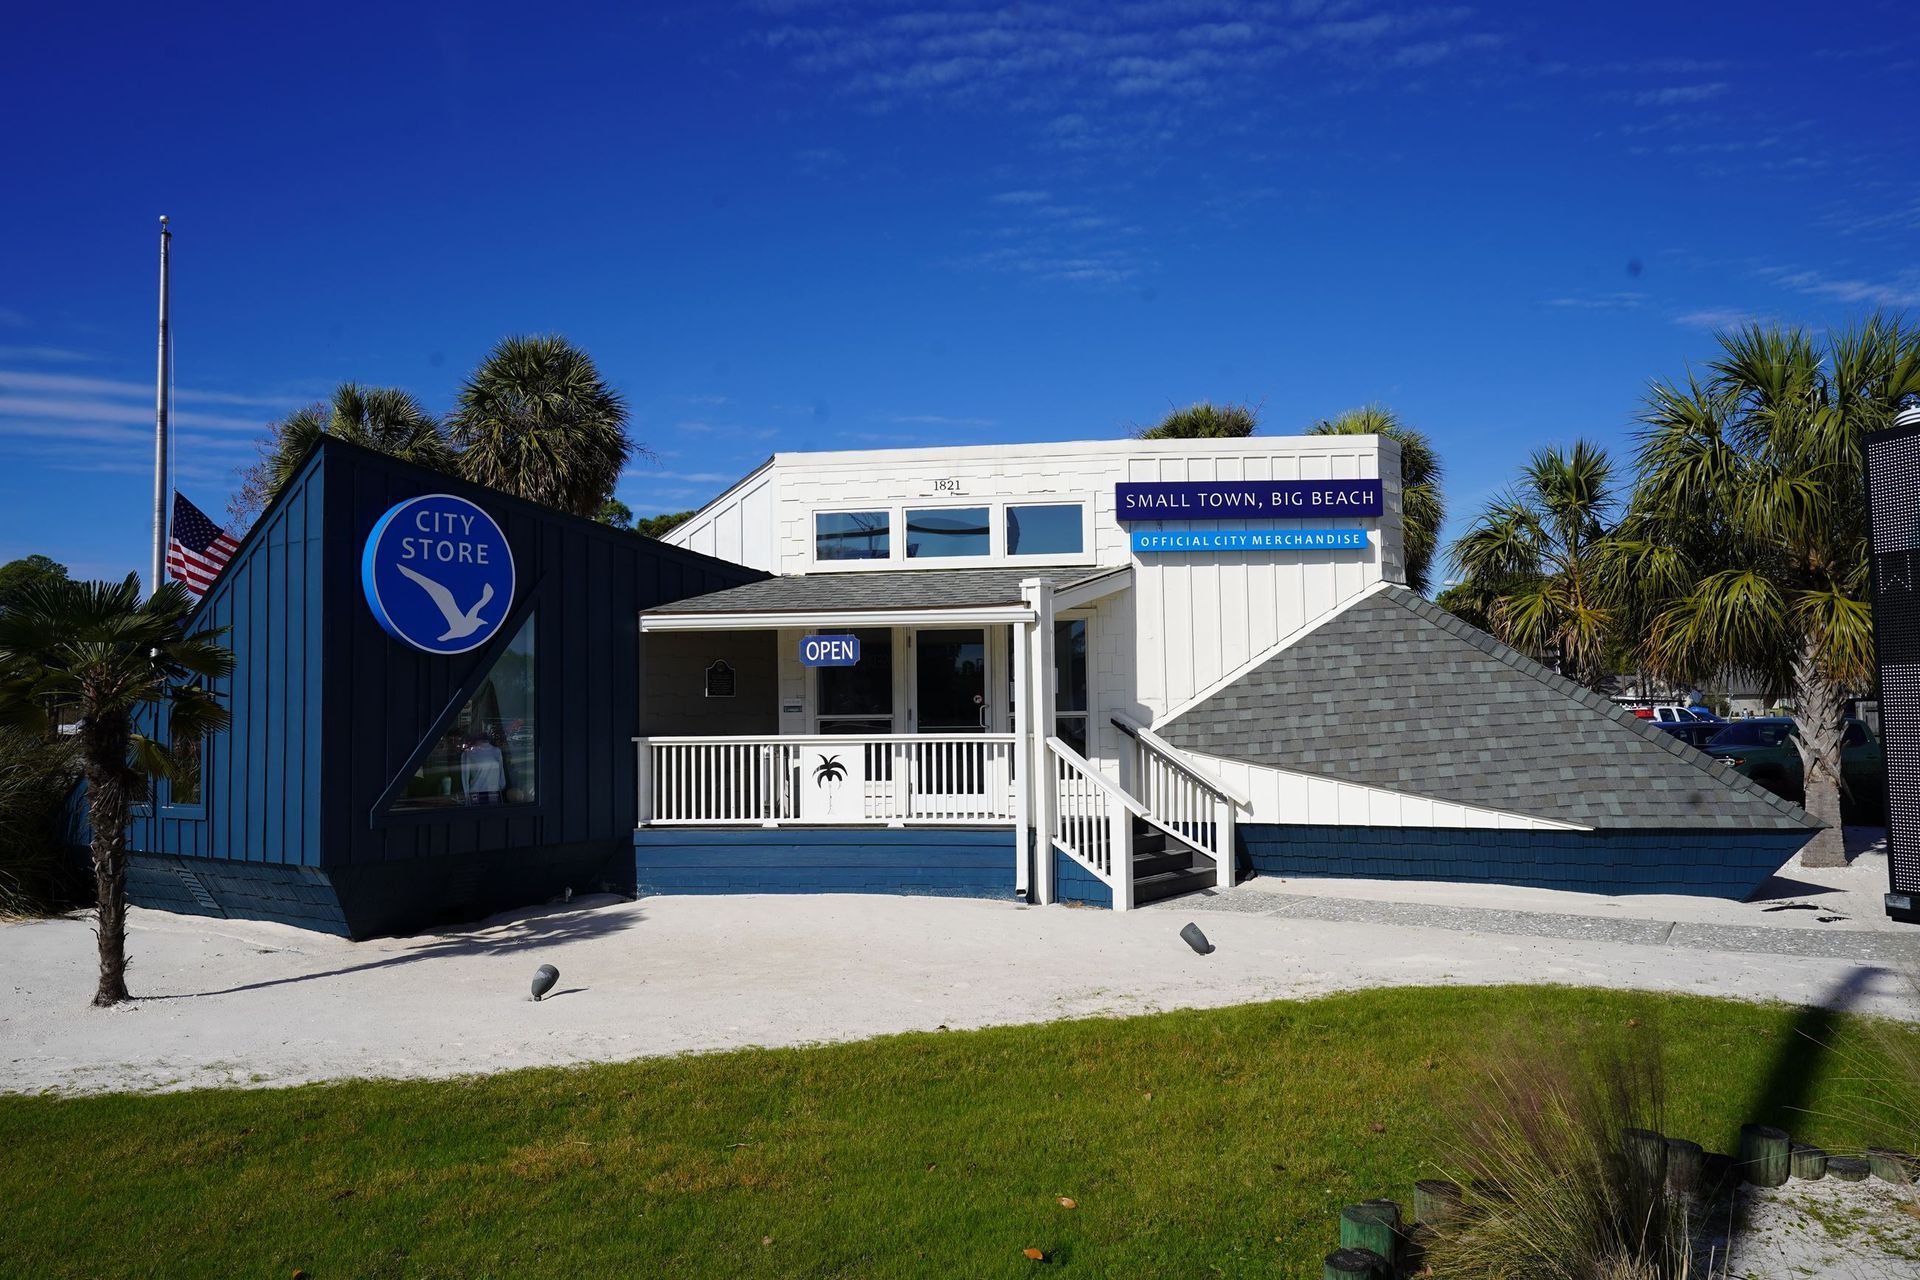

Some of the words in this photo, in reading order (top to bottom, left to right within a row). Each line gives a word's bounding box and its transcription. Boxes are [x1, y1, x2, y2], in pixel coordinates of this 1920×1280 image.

[934, 480, 961, 491] 1821
[1126, 493, 1191, 508] SMALL
[1197, 492, 1263, 510] TOWN,
[1271, 491, 1303, 506] BIG
[1311, 490, 1374, 506] BEACH
[415, 510, 476, 536] CITY
[401, 537, 489, 565] STORE
[1140, 536, 1210, 547] OFFICIAL
[1214, 535, 1247, 546] CITY
[1252, 534, 1361, 546] MERCHANDISE
[806, 640, 853, 662] OPEN
